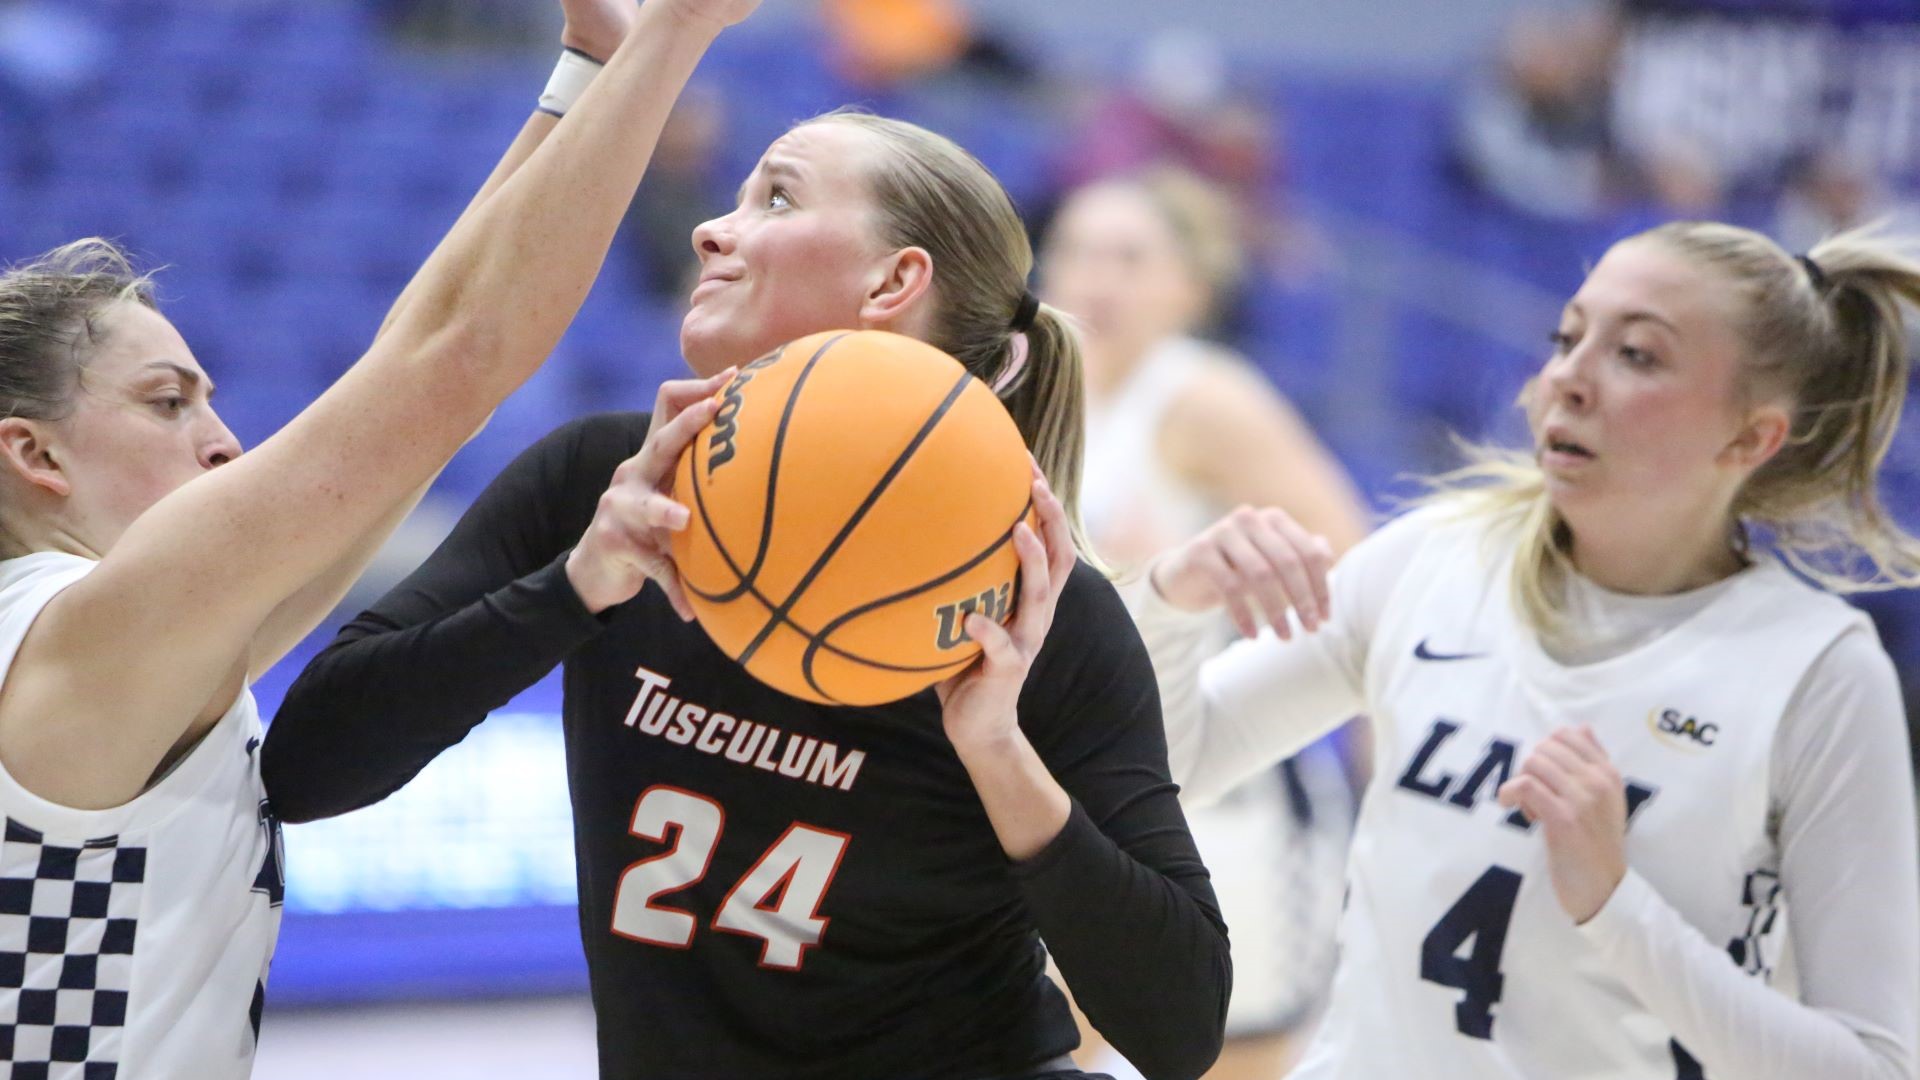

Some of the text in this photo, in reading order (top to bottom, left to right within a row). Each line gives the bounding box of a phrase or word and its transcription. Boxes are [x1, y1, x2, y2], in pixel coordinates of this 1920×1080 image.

[1657, 707, 1719, 747] SAC
[610, 783, 851, 971] 24
[1420, 865, 1523, 1041] 4
